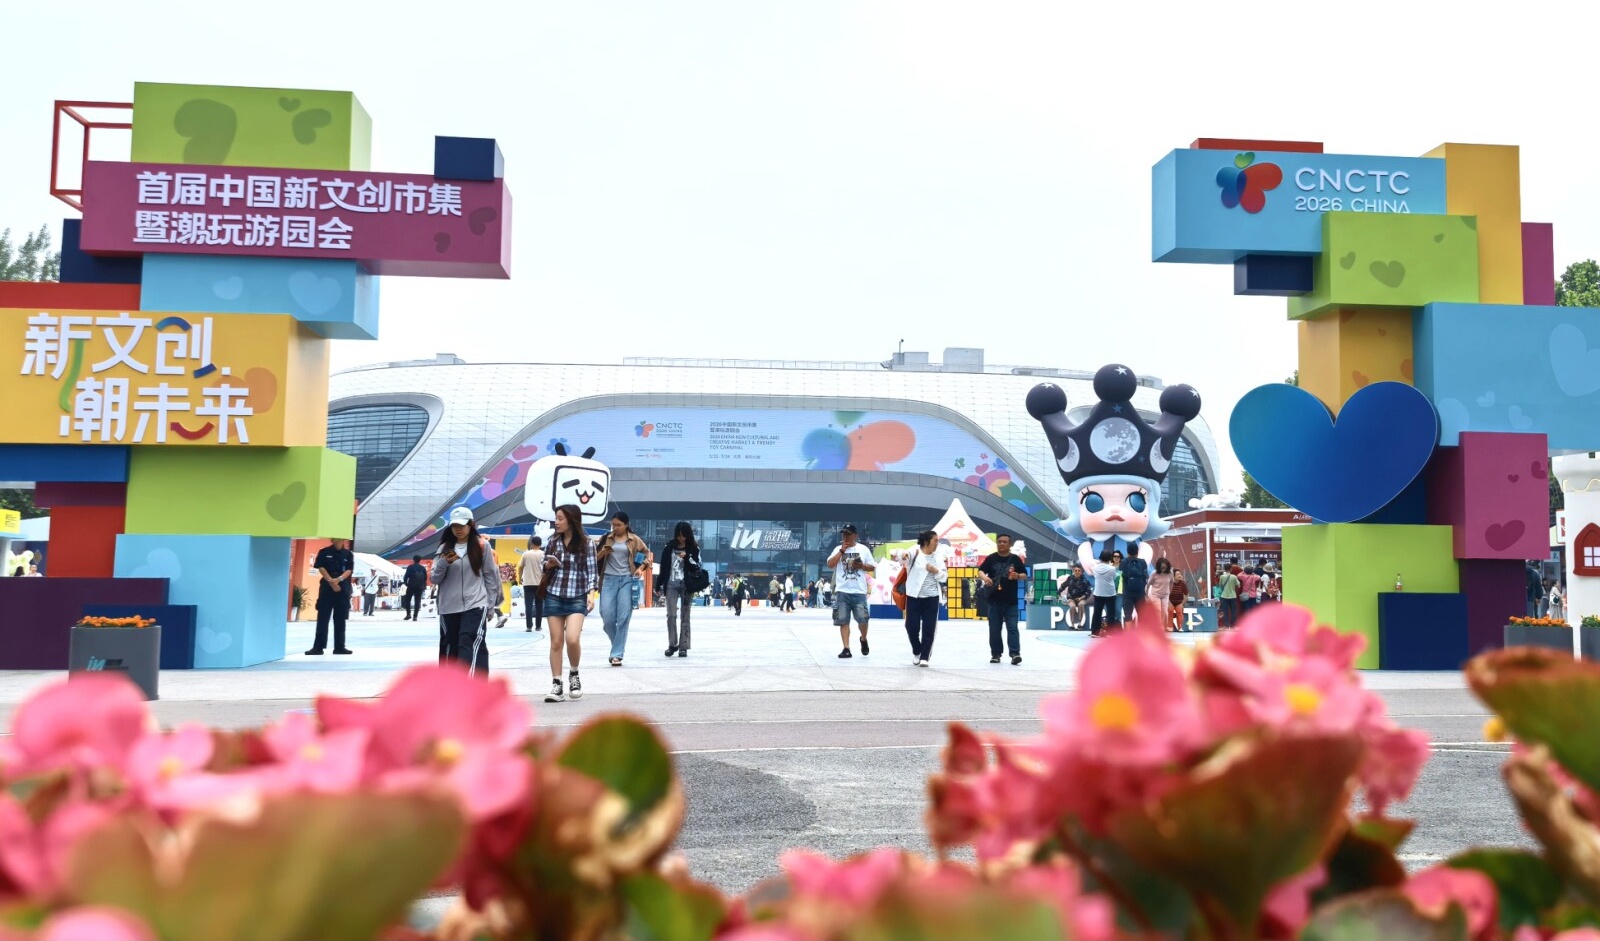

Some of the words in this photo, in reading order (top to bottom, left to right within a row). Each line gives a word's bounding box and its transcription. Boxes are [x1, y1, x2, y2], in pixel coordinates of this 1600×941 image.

[136, 171, 463, 217] 首届中国新文创市集
[1295, 167, 1411, 195] CNCTC
[1295, 196, 1343, 212] 2026
[1350, 198, 1411, 213] CHINA
[133, 210, 354, 250] 暨潮玩游园会
[59, 377, 254, 444] 潮未来
